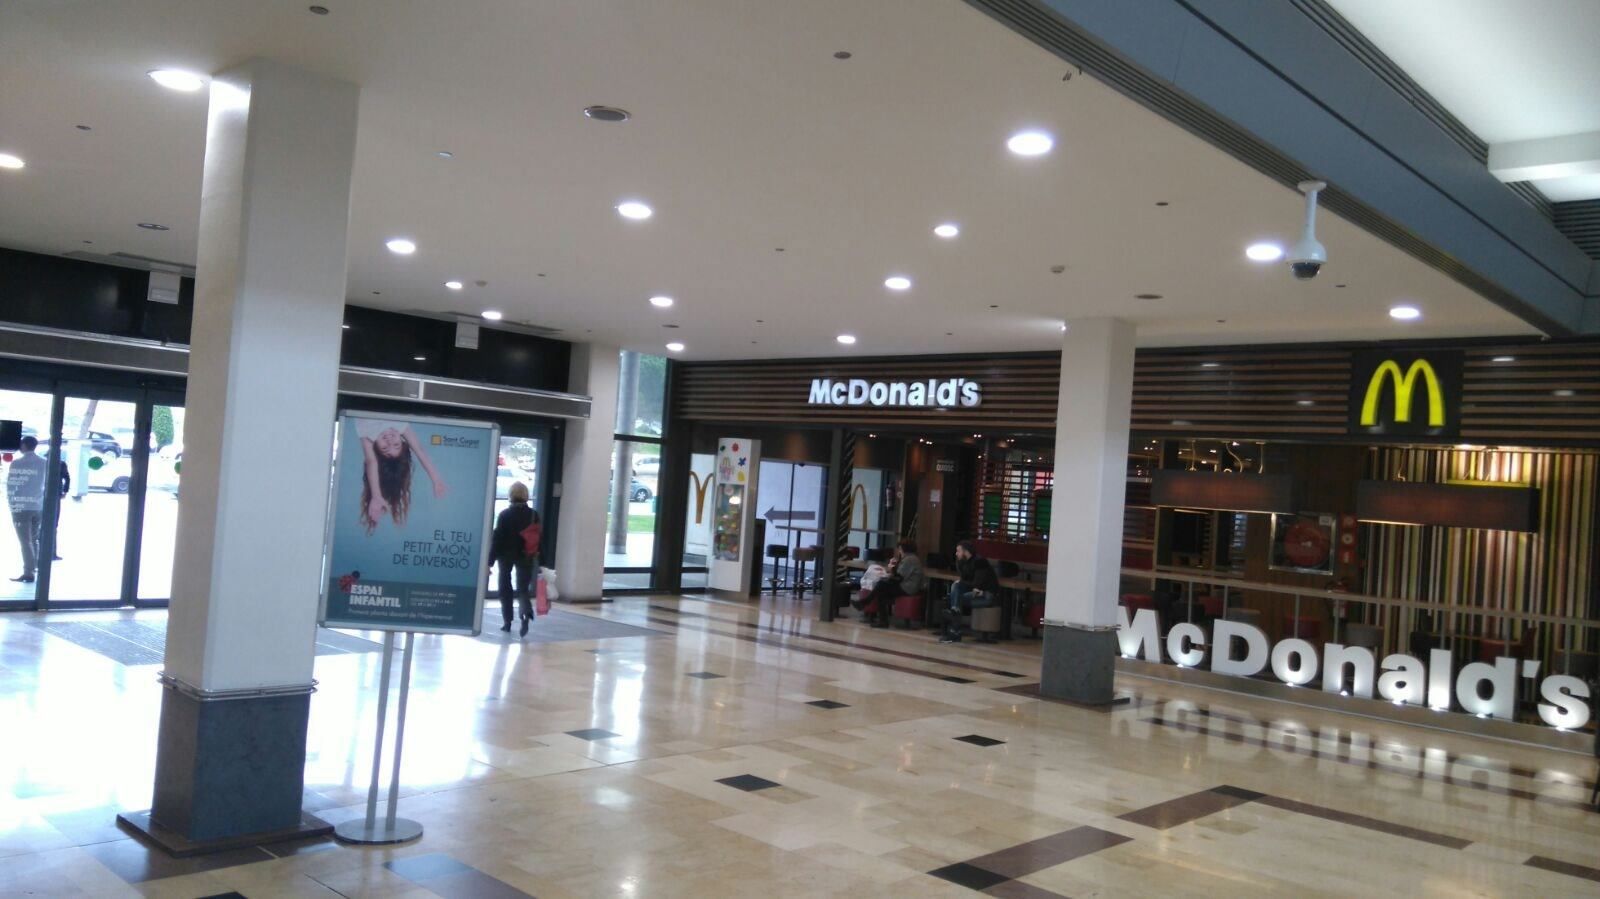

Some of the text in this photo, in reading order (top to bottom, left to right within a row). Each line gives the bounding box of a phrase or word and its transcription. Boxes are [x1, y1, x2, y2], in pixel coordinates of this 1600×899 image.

[807, 378, 981, 407] McDonald's
[433, 529, 472, 543] EL TEU
[403, 540, 434, 553] PETIT
[392, 553, 470, 570] DE DIVERSIÓ
[350, 584, 383, 596] ESPAI
[349, 594, 402, 608] INFANTIL
[1116, 604, 1591, 730] McDonald's
